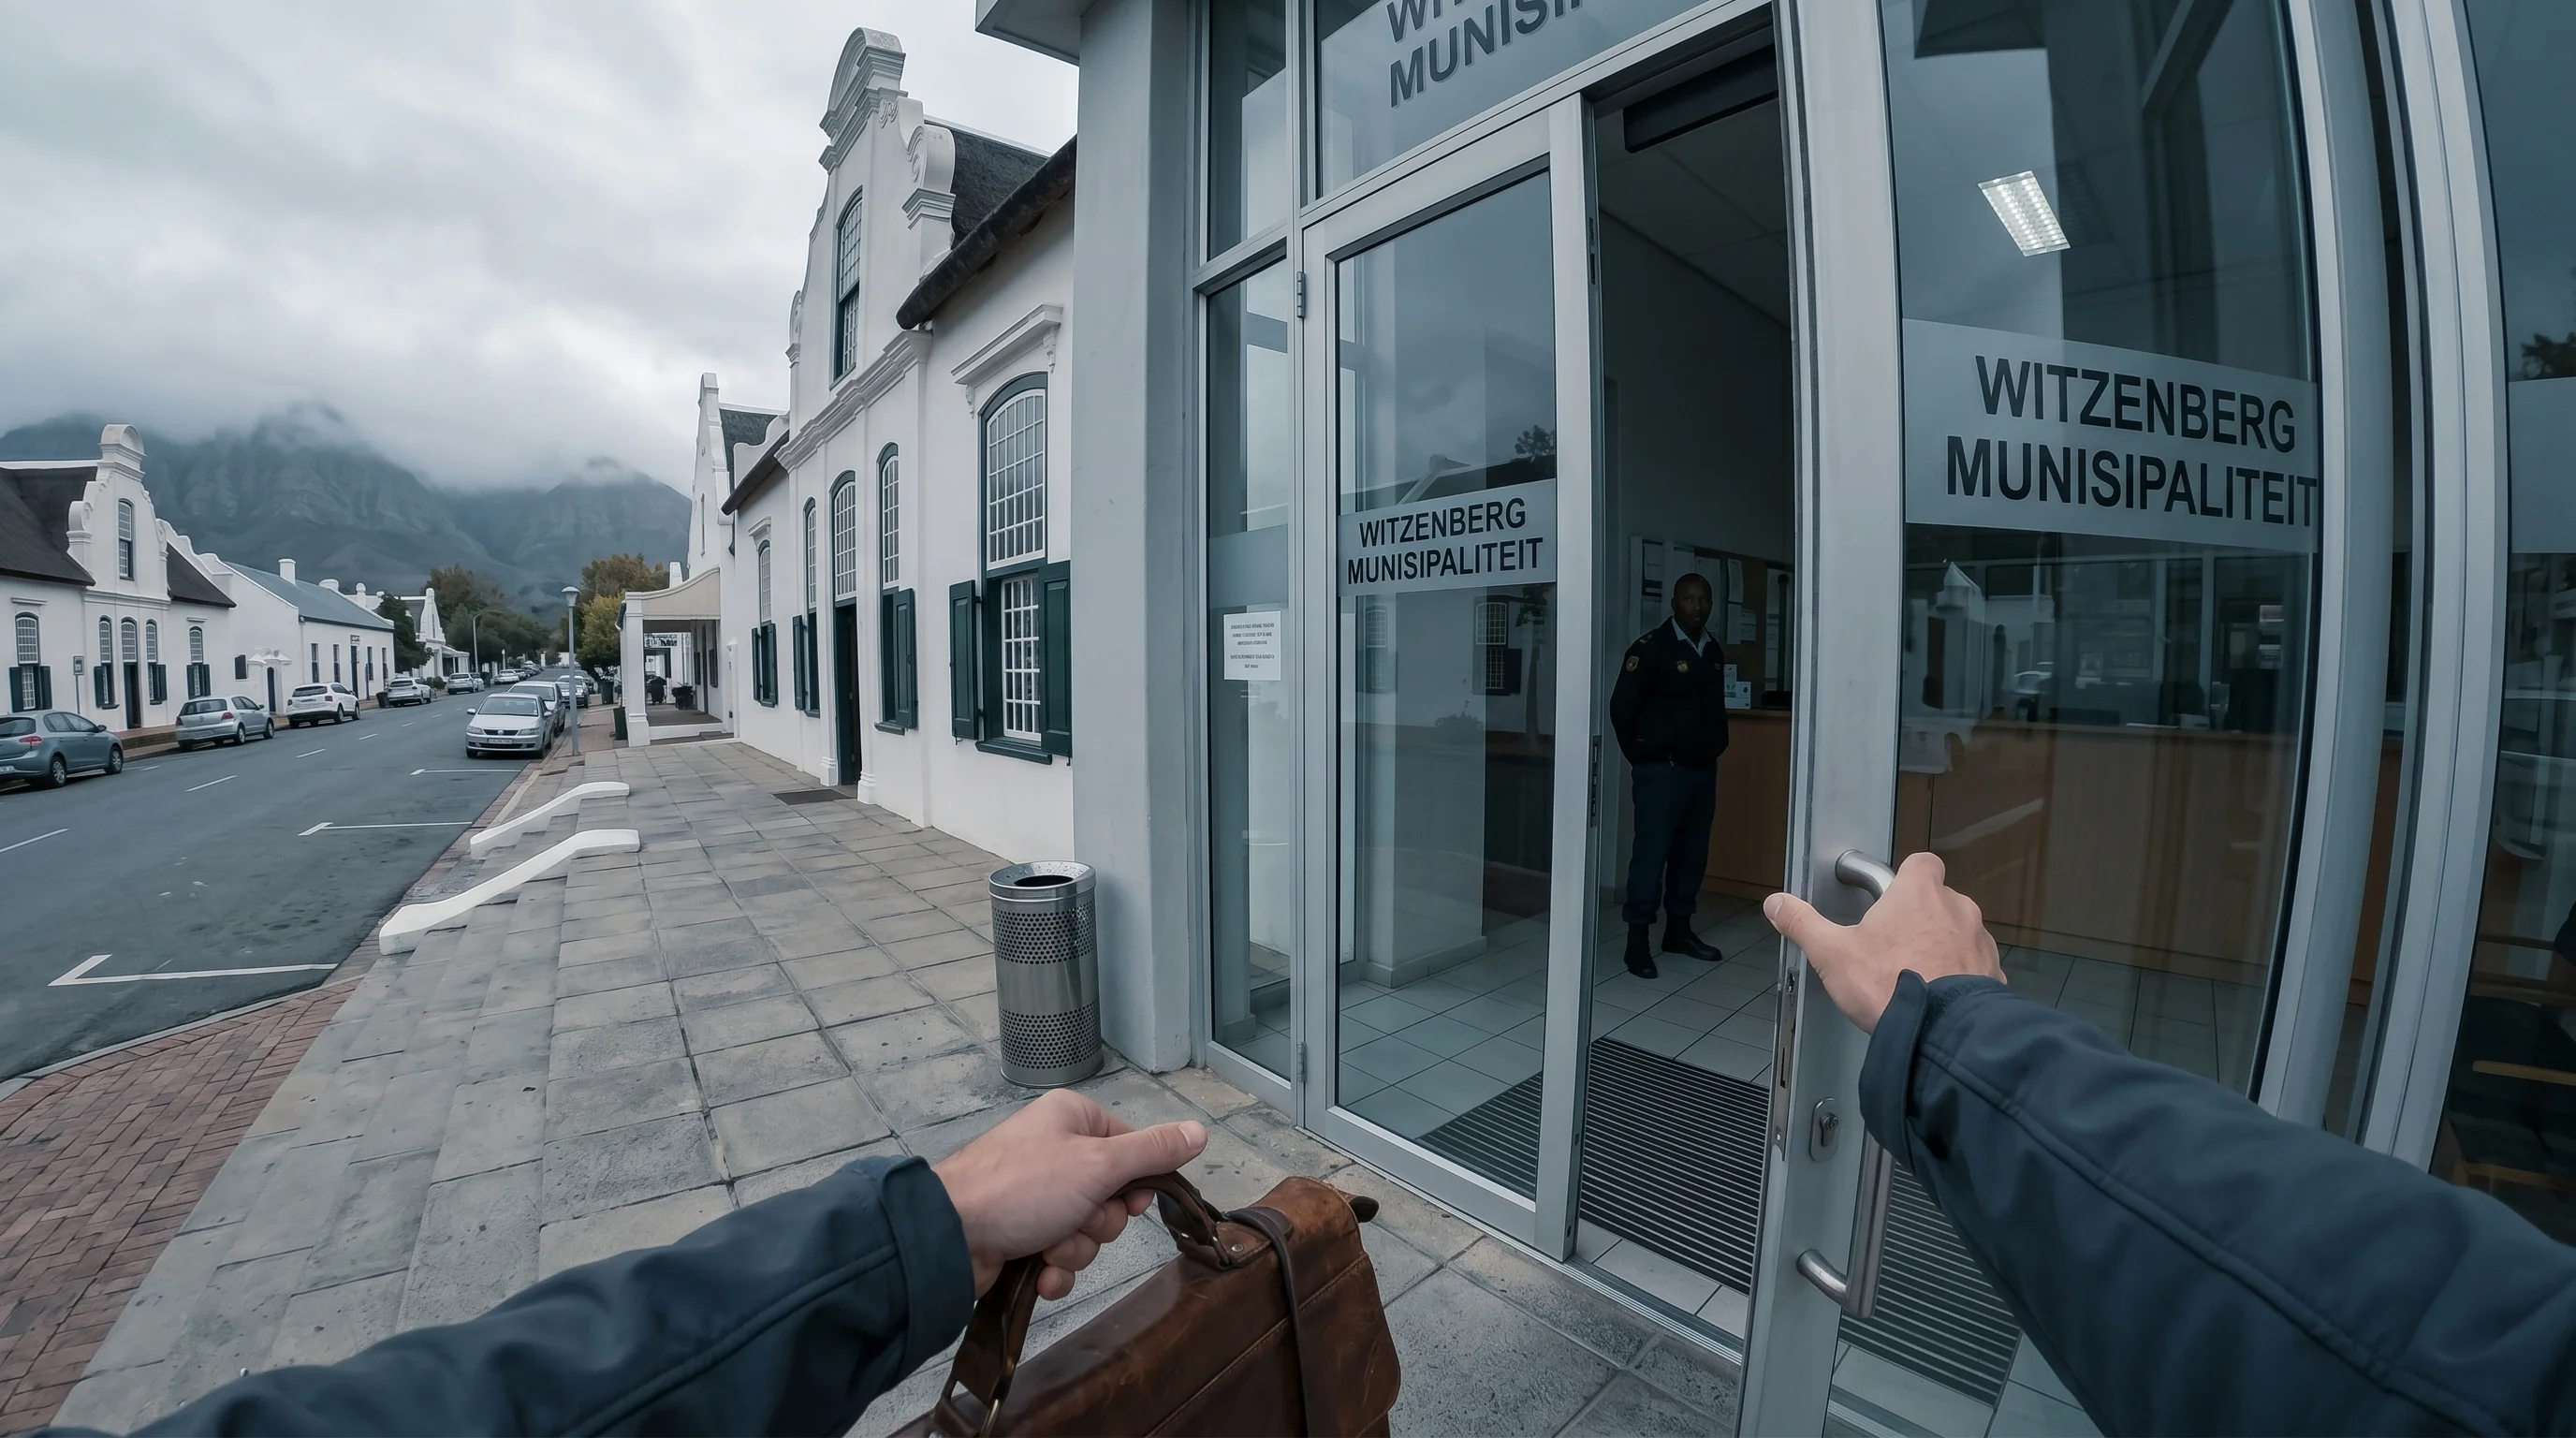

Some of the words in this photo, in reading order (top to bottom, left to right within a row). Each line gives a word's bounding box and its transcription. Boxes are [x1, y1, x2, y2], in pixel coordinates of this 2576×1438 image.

[1390, 0, 1580, 108] MUNIS
[1975, 355, 2296, 453] WITZENBERG
[1359, 497, 1526, 548] WITZENBERG
[1947, 435, 2318, 527] MUNISIPALITEIT
[1348, 536, 1544, 585] MUNISIPALITEIT
